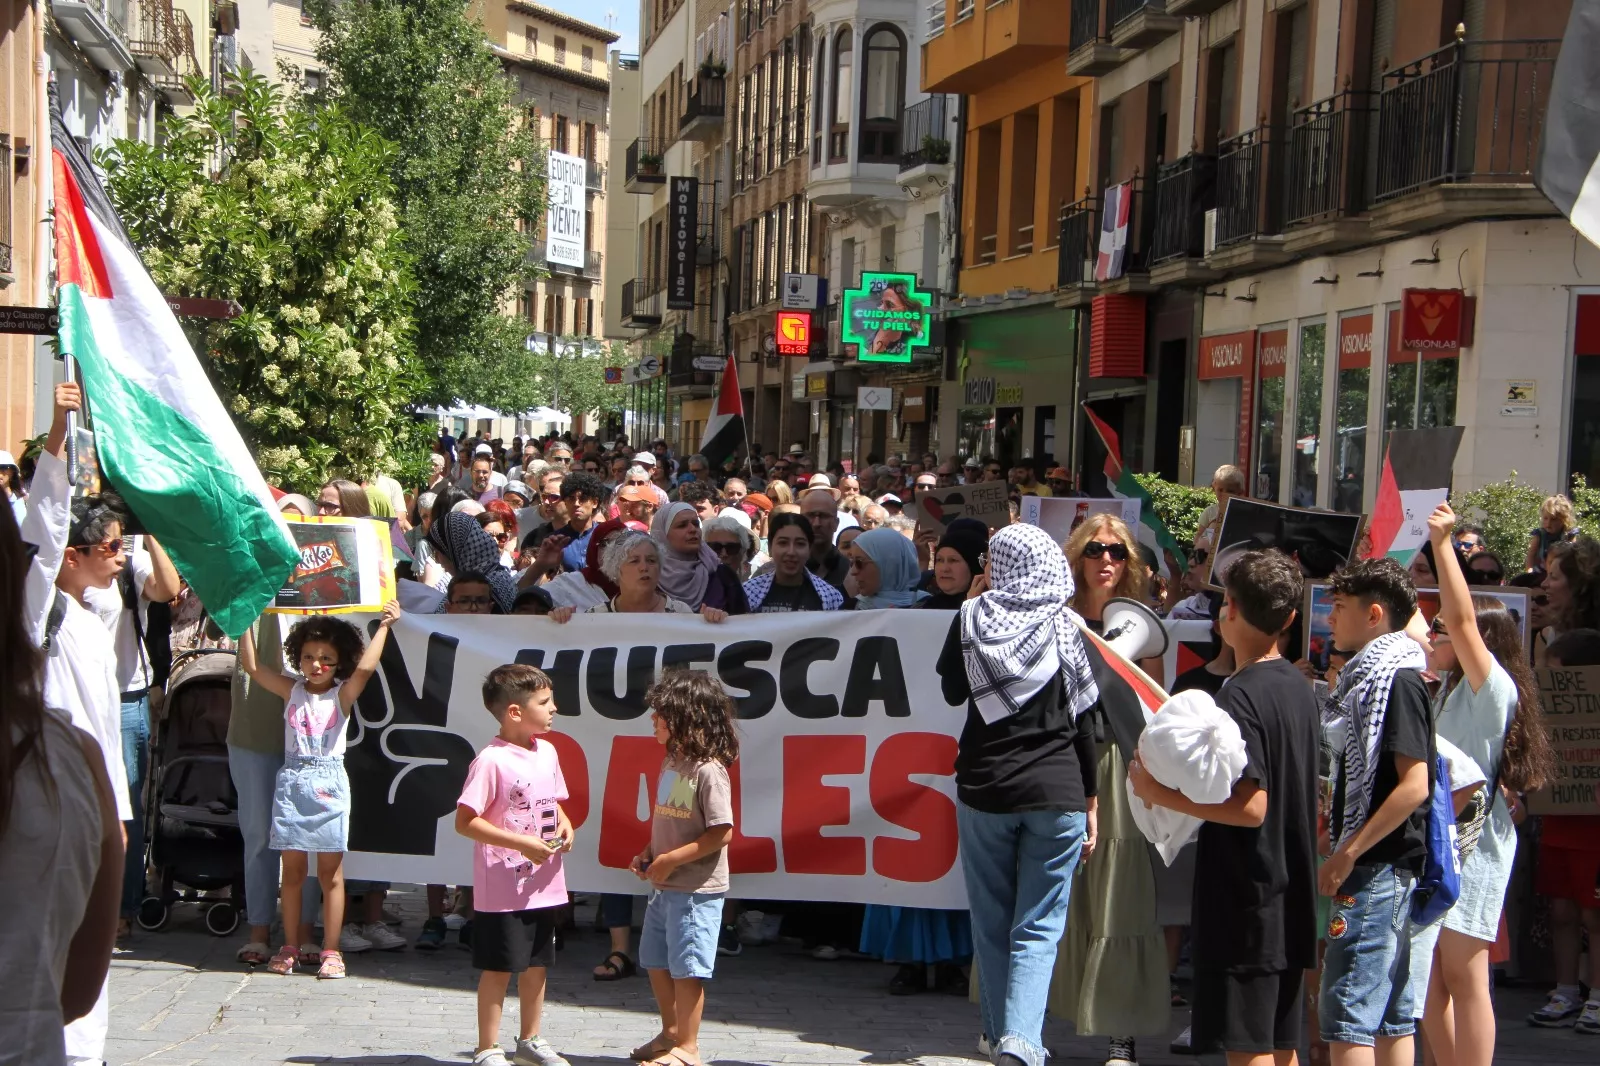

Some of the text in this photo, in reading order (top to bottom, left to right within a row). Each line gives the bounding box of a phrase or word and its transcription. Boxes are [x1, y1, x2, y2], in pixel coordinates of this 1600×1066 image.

[551, 157, 583, 187] EDIFICIO
[563, 184, 573, 206] EN
[552, 206, 581, 238] VENTA
[676, 180, 690, 297] Montovelaz
[13, 310, 46, 321] Claustro
[854, 308, 921, 321] CUIDAMOS
[18, 321, 25, 329] el
[26, 321, 46, 332] Viejo
[863, 321, 912, 333] TU PIEL
[779, 344, 808, 355] 12:35
[1341, 331, 1372, 354] VISIONLAB
[1405, 339, 1457, 349] VISIONLAB
[1211, 343, 1242, 369] VISIONLAB
[971, 486, 1003, 502] FREE
[1535, 670, 1587, 691] LIBRE
